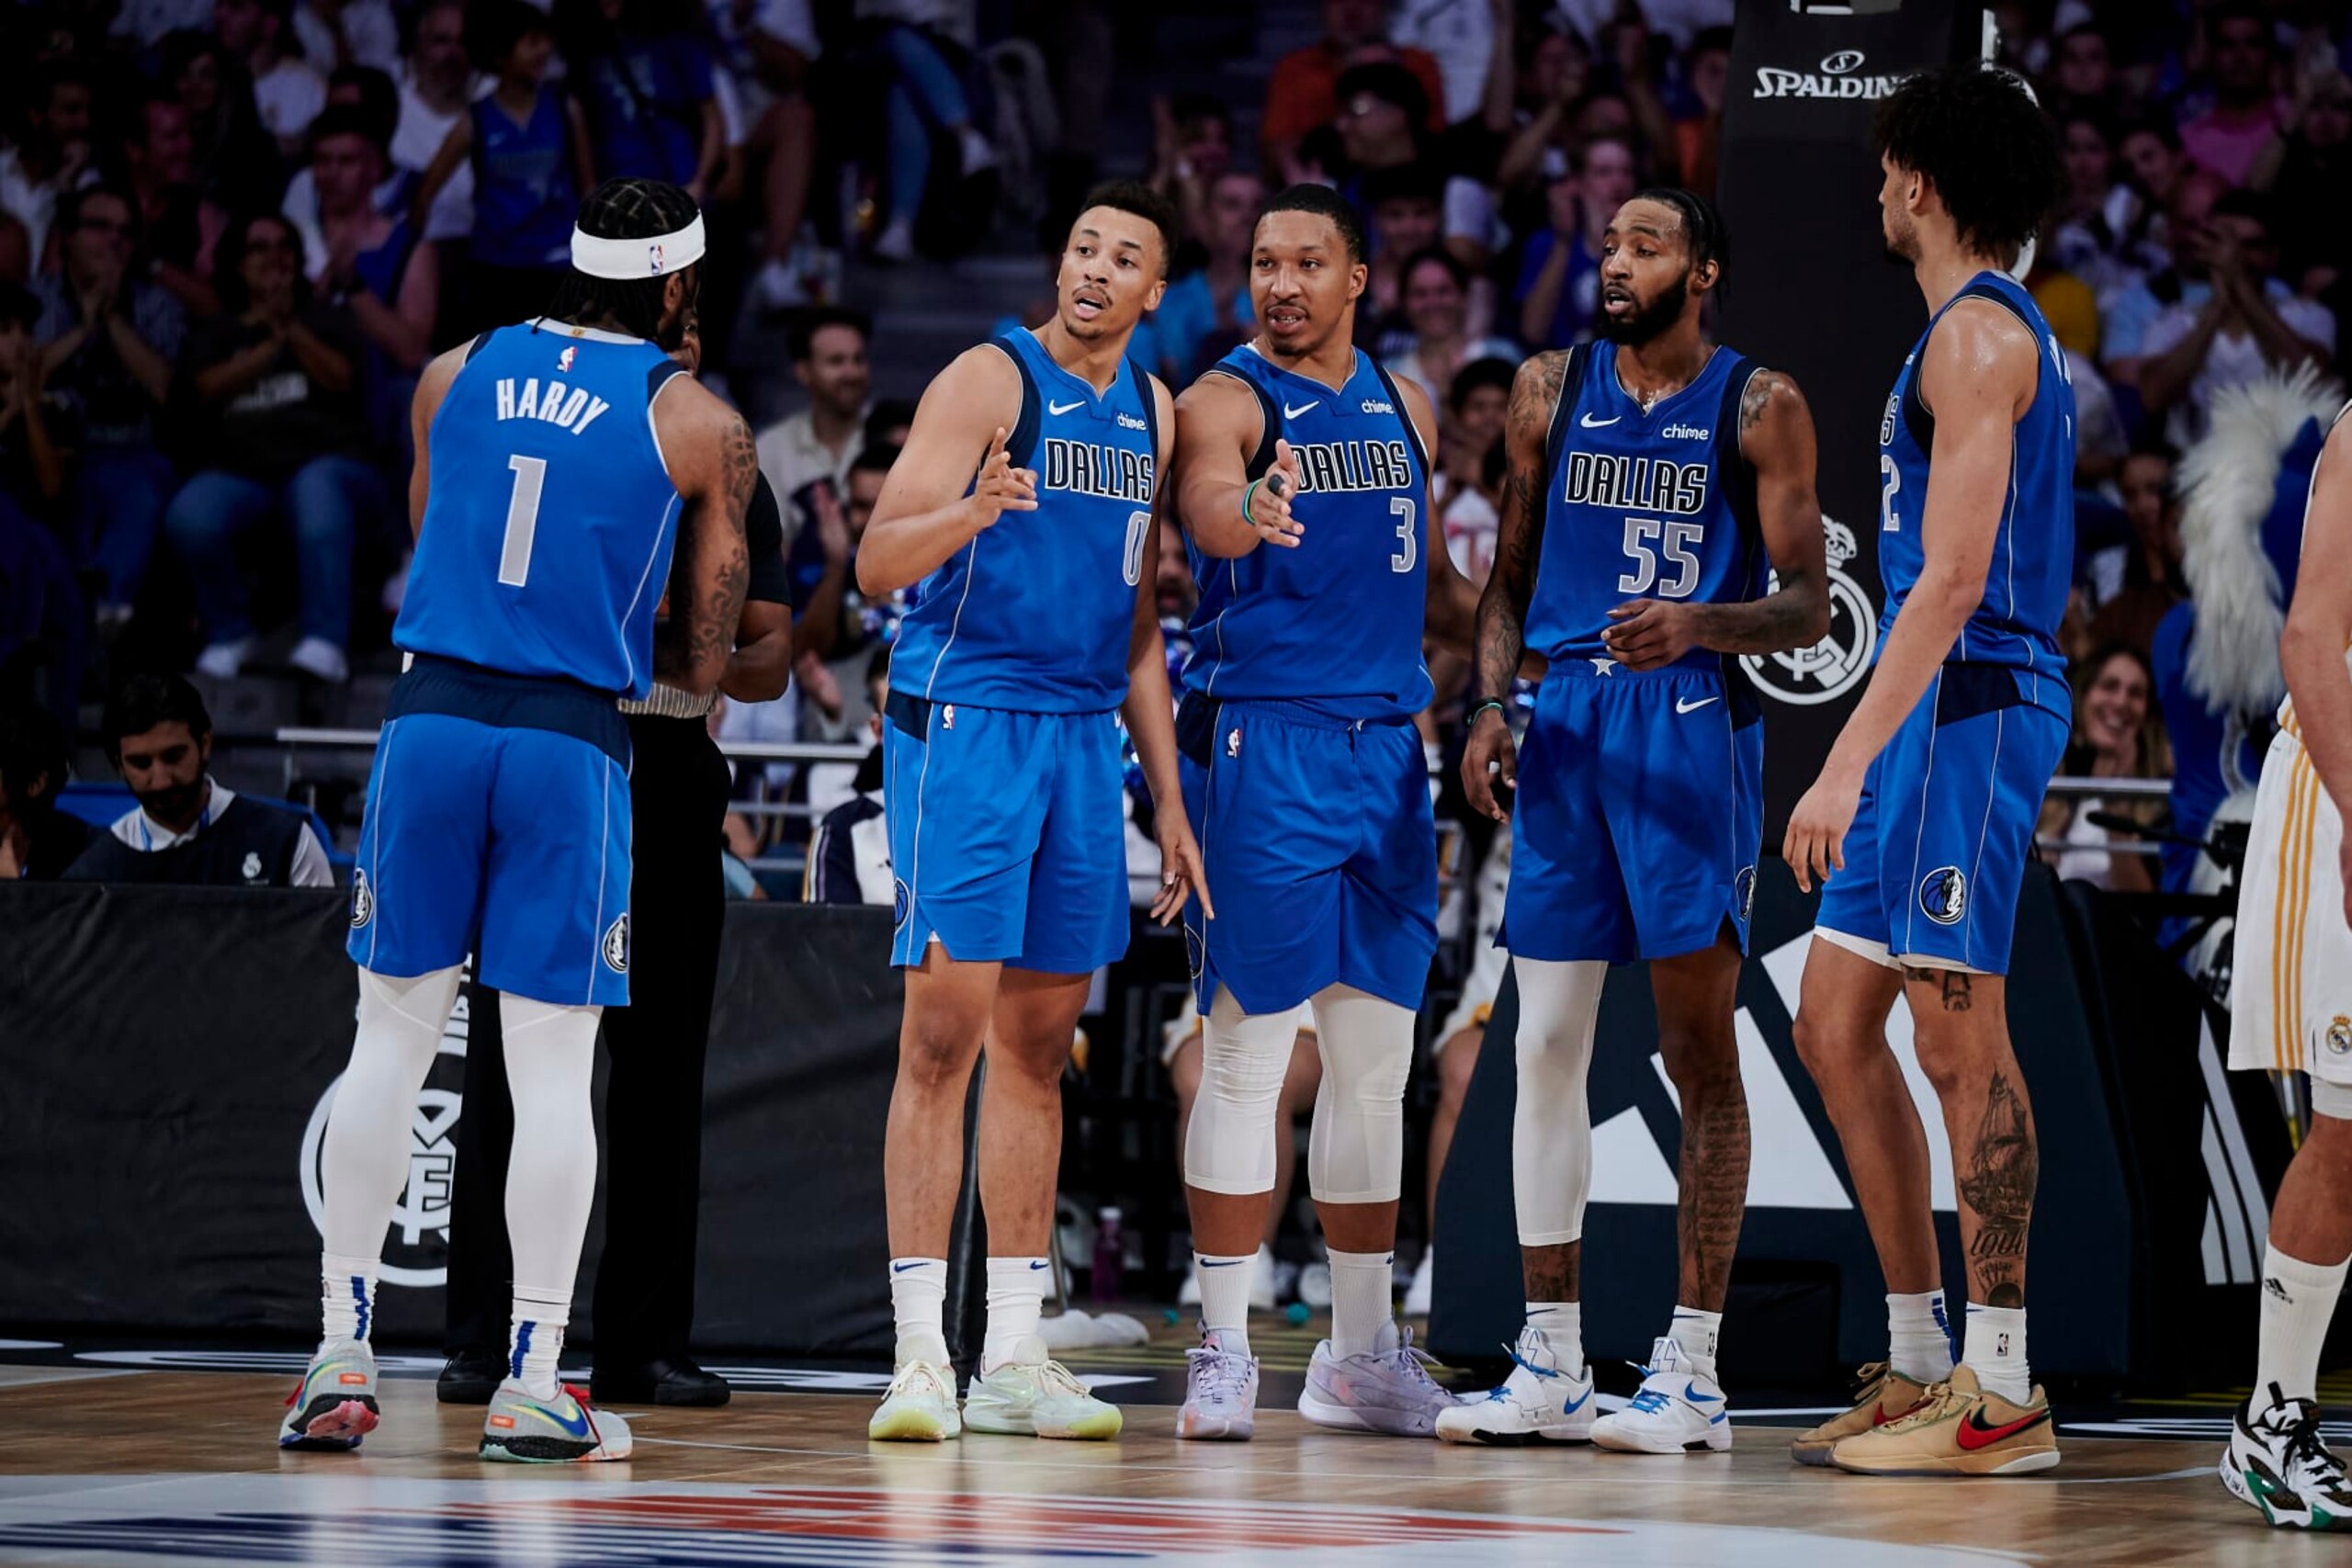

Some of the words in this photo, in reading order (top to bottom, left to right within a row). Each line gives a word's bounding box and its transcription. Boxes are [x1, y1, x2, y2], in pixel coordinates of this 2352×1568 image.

[1753, 67, 1911, 99] SPALDIN
[496, 378, 610, 435] HARDY
[1117, 412, 1147, 431] chime
[1361, 399, 1394, 414] chime
[1662, 423, 1709, 441] chime
[1045, 437, 1153, 504] DALLAS
[1565, 451, 1709, 514] DALLAS
[498, 454, 548, 587] 1
[1122, 510, 1152, 586] 0
[1389, 496, 1417, 573] 3
[1618, 516, 1704, 597] 55
